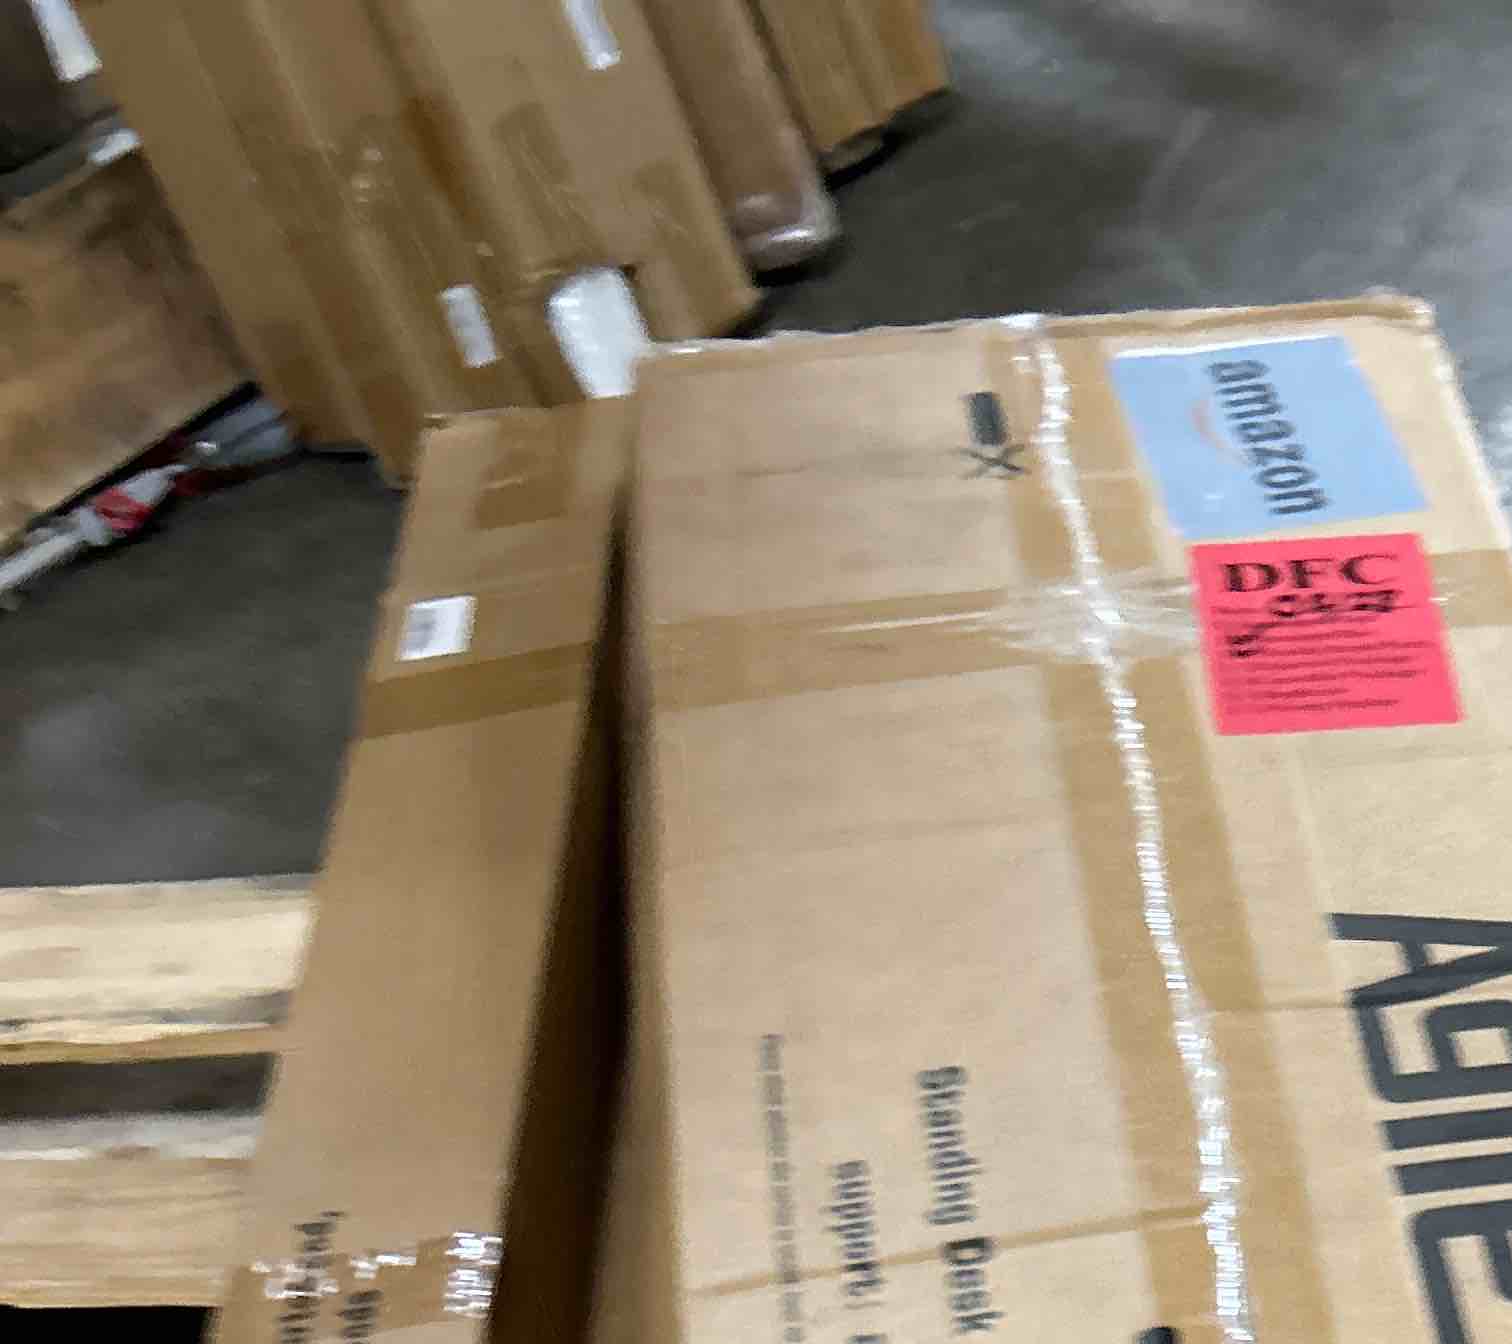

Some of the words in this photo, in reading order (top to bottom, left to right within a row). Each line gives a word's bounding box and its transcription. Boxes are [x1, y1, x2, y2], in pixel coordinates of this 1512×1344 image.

[1206, 358, 1330, 515] amazon
[1218, 553, 1399, 593] DFC
[915, 1066, 983, 1225] Standing
[940, 1237, 1005, 1335] Desk
